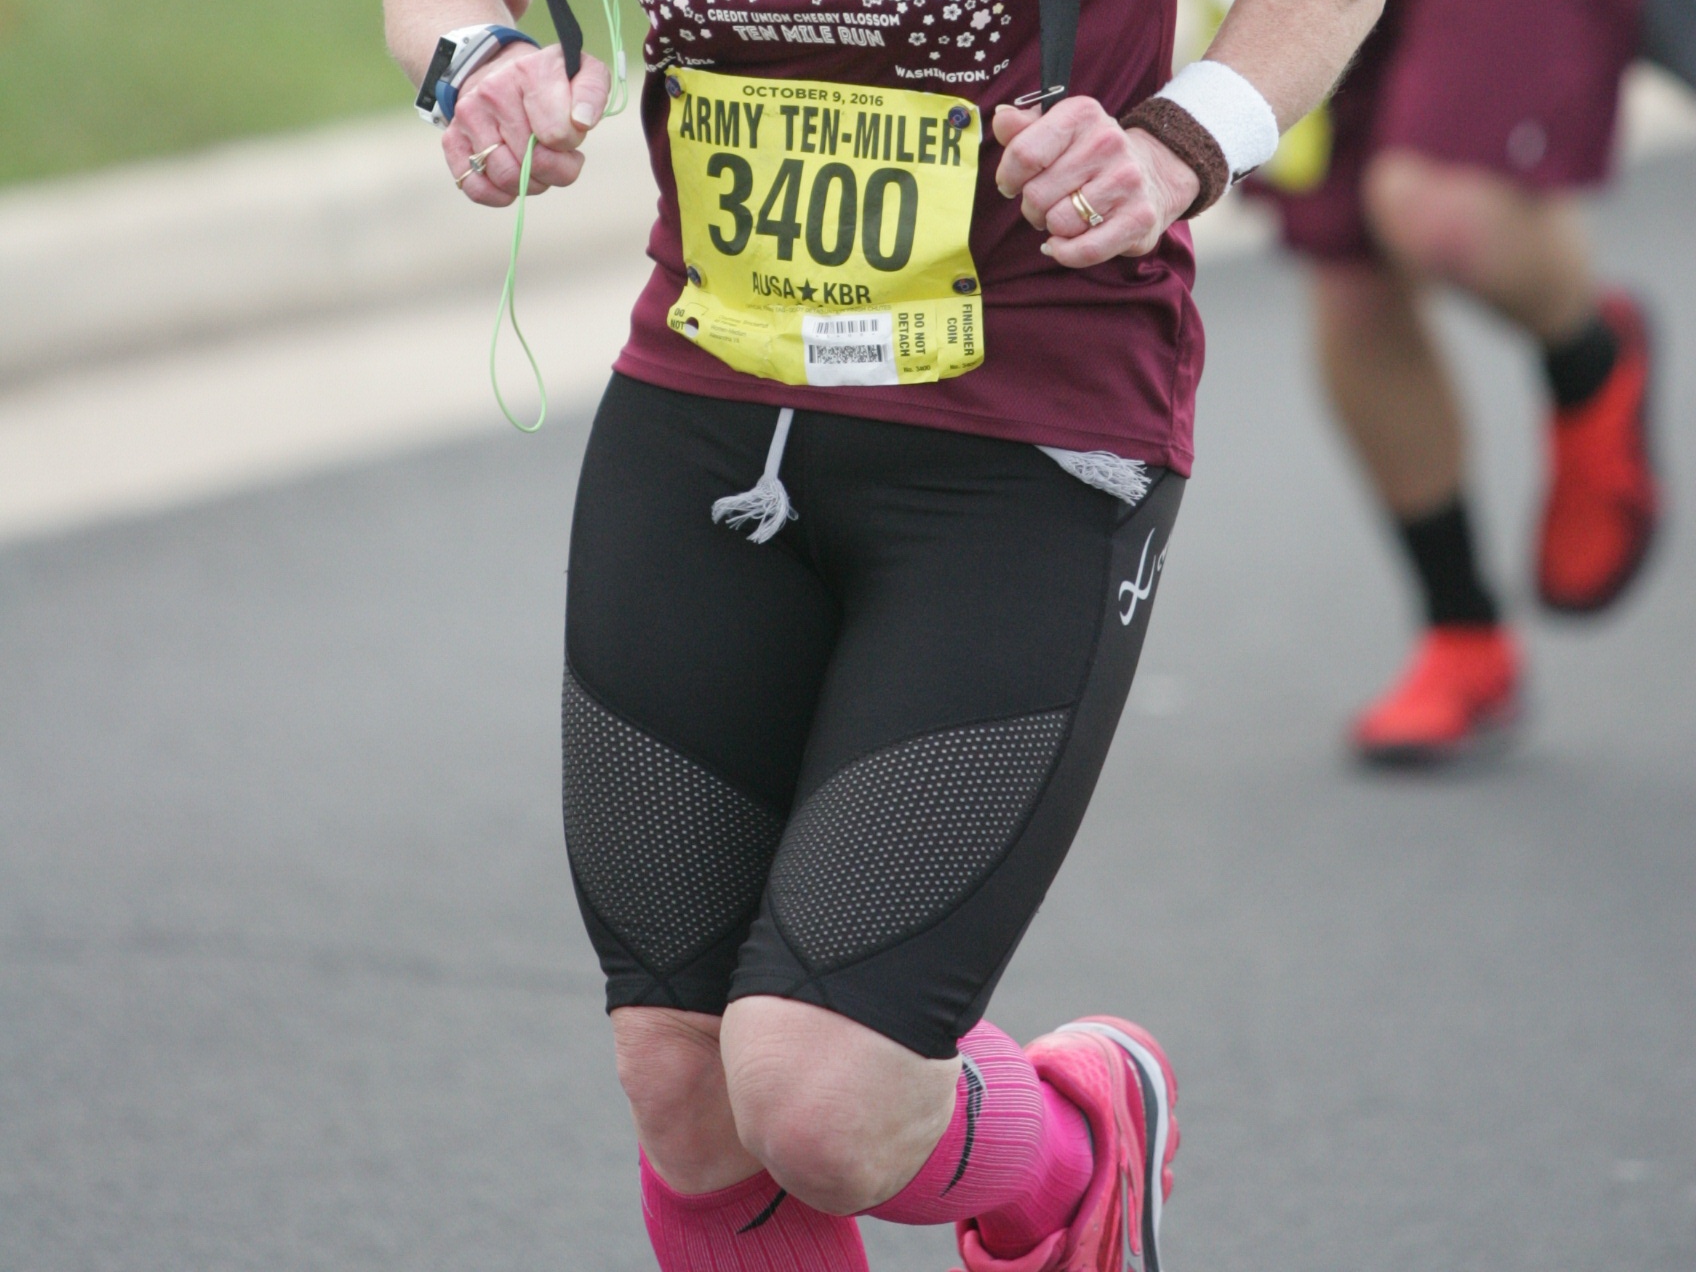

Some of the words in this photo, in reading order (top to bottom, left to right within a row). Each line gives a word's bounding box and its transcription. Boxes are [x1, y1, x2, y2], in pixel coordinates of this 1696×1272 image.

[707, 9, 749, 23] CREDIT
[751, 12, 792, 24] UNION
[793, 13, 841, 25] CHERRY
[842, 12, 901, 27] BLOSSOM
[733, 25, 780, 42] TEN
[781, 25, 836, 45] MILE
[837, 26, 886, 47] RUN
[993, 59, 1010, 75] DC
[742, 84, 828, 101] OCTOBER
[832, 91, 845, 105] 9,
[850, 93, 884, 107] 2016
[680, 93, 764, 149] ARMY
[779, 104, 963, 166] TEN-MILER
[706, 152, 919, 273] 3400
[752, 271, 796, 300] AUSA
[823, 281, 871, 305] KBR
[674, 307, 686, 318] DO
[913, 312, 925, 328] DO
[670, 318, 685, 331] NOT
[898, 312, 910, 357] DETACH
[947, 317, 958, 345] COIN
[962, 303, 974, 356] FINISHER
[914, 332, 926, 355] NOT
